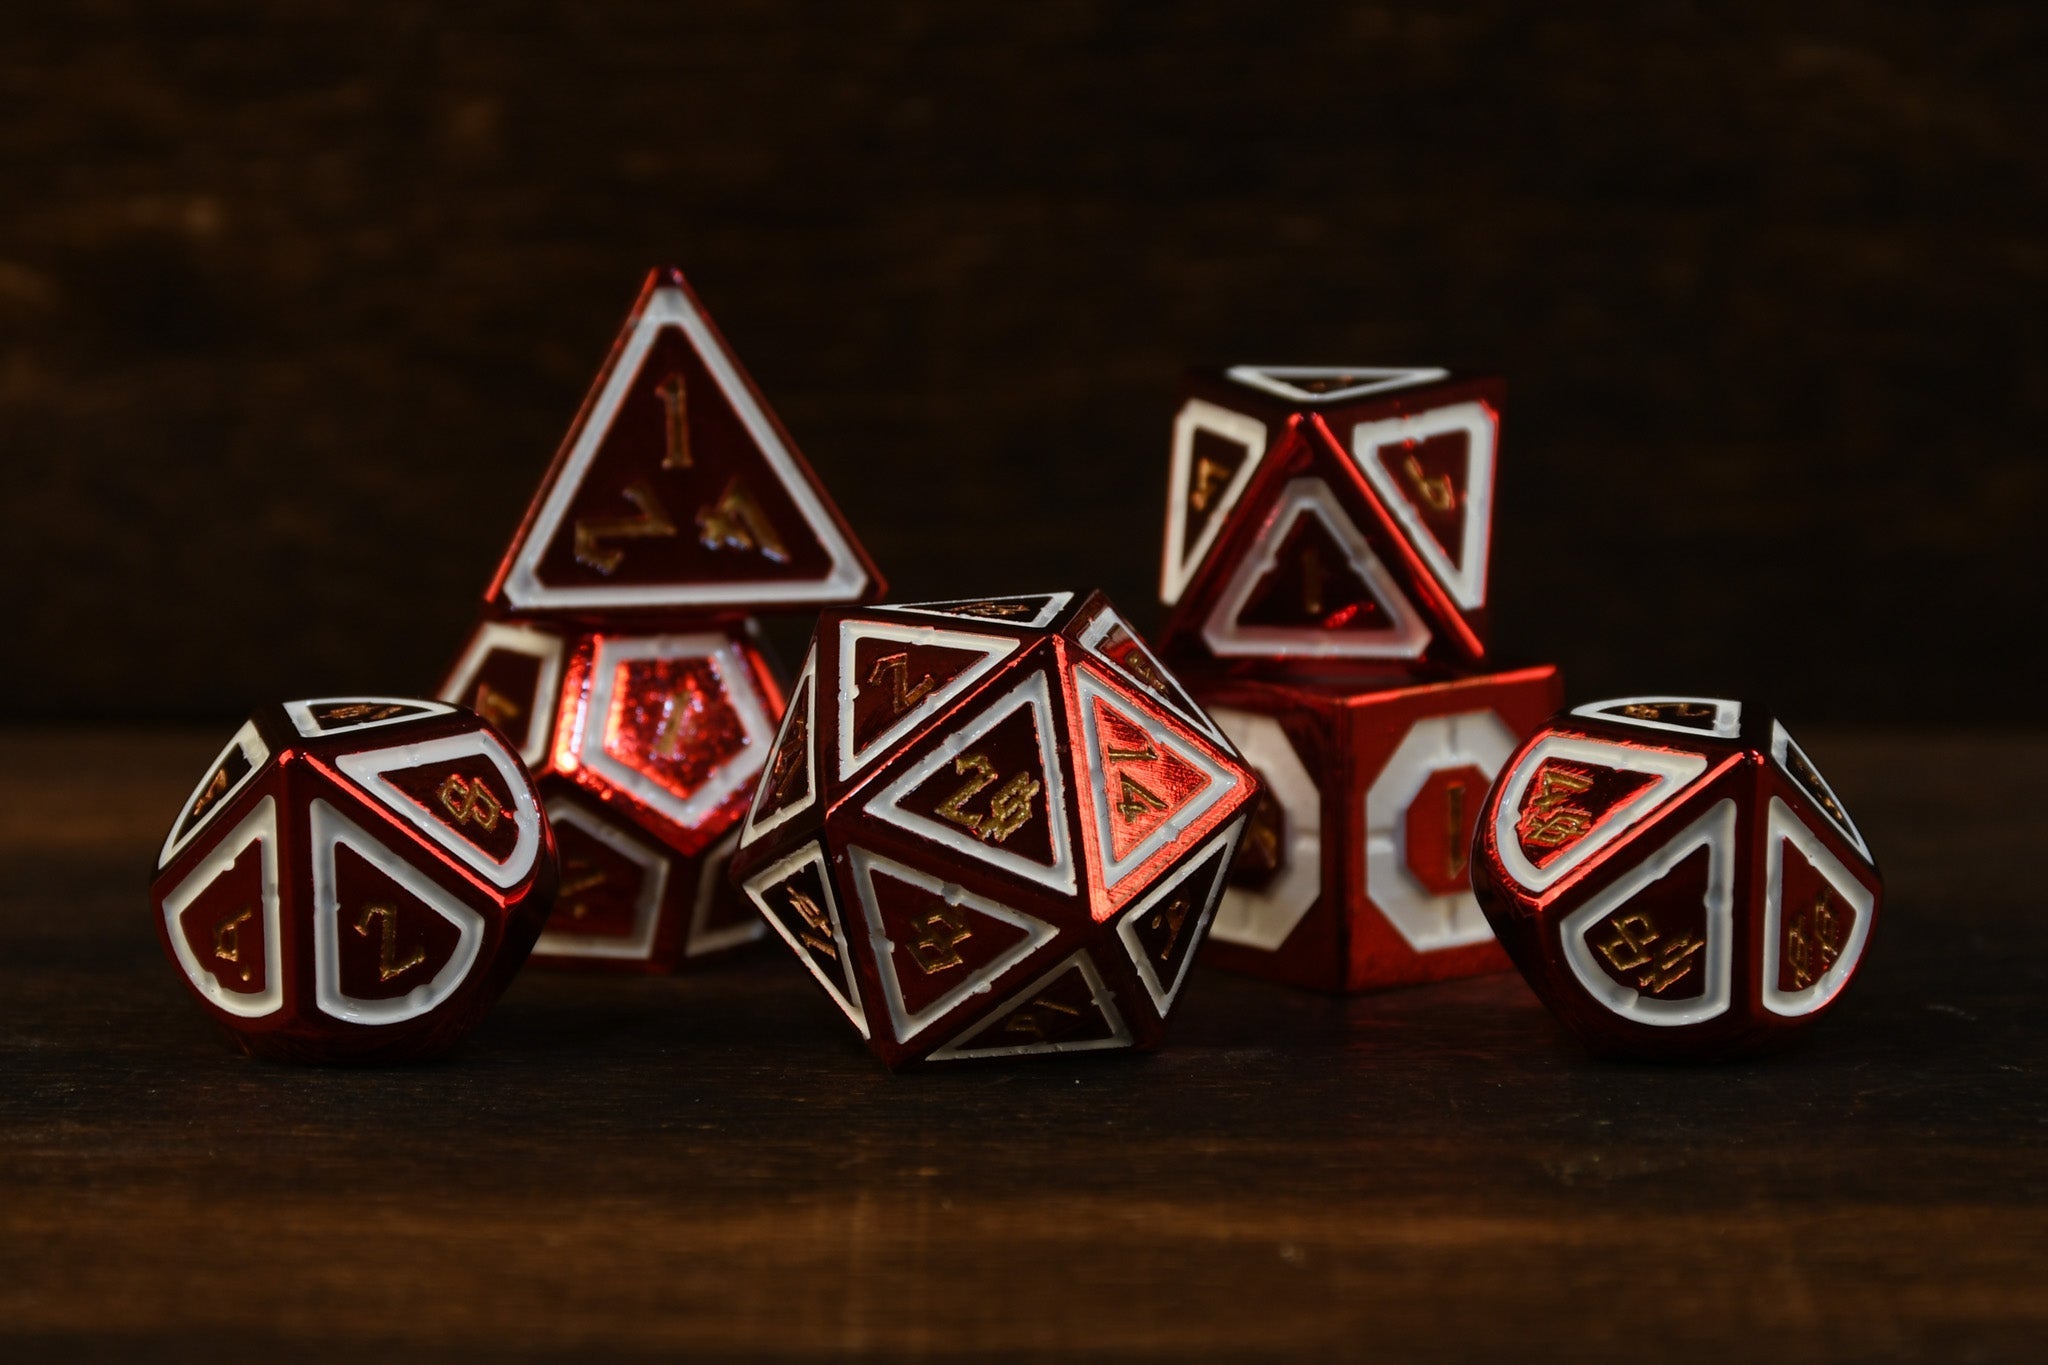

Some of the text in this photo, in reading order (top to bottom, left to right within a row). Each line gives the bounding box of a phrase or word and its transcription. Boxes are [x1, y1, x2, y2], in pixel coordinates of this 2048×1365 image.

[655, 373, 694, 469] 1
[867, 652, 937, 715] 2
[437, 772, 500, 834] 8
[933, 753, 1038, 843] 20
[1107, 745, 1169, 823] 14
[352, 902, 427, 982] 2
[906, 904, 974, 976] 8
